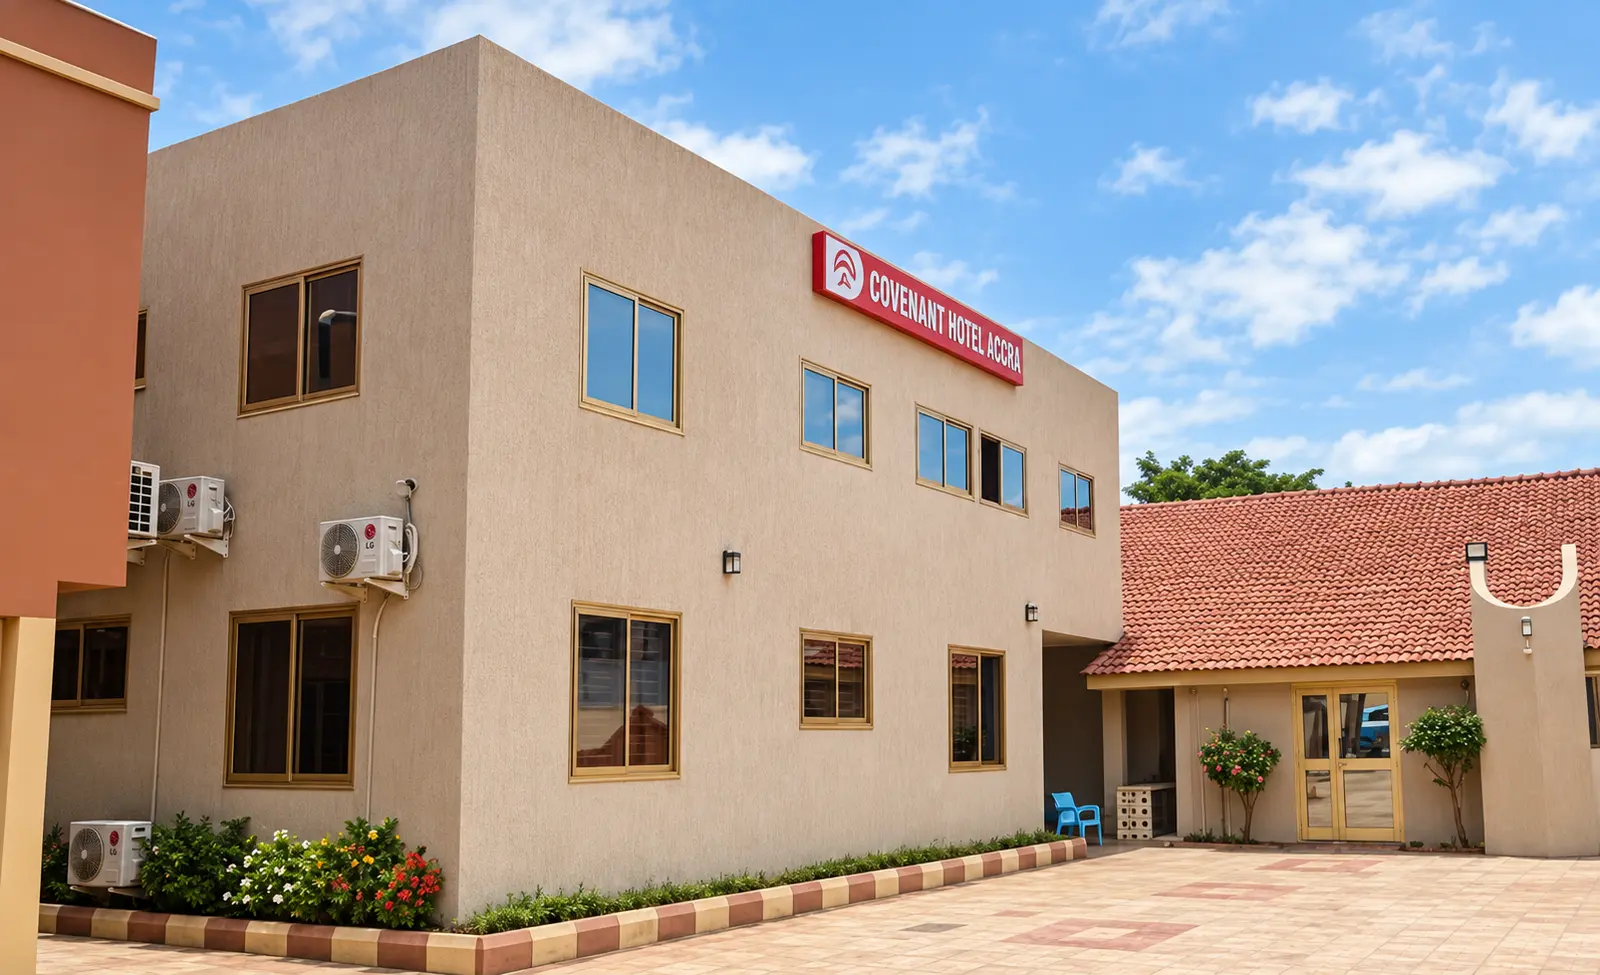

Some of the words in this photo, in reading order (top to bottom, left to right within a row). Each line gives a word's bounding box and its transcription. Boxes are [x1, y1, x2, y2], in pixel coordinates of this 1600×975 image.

[869, 270, 944, 334] COVENANT
[948, 310, 984, 355] HOTEL
[987, 332, 1021, 373] ACCRA
[187, 500, 195, 508] LG
[365, 541, 375, 549] LG
[109, 848, 117, 856] LG
